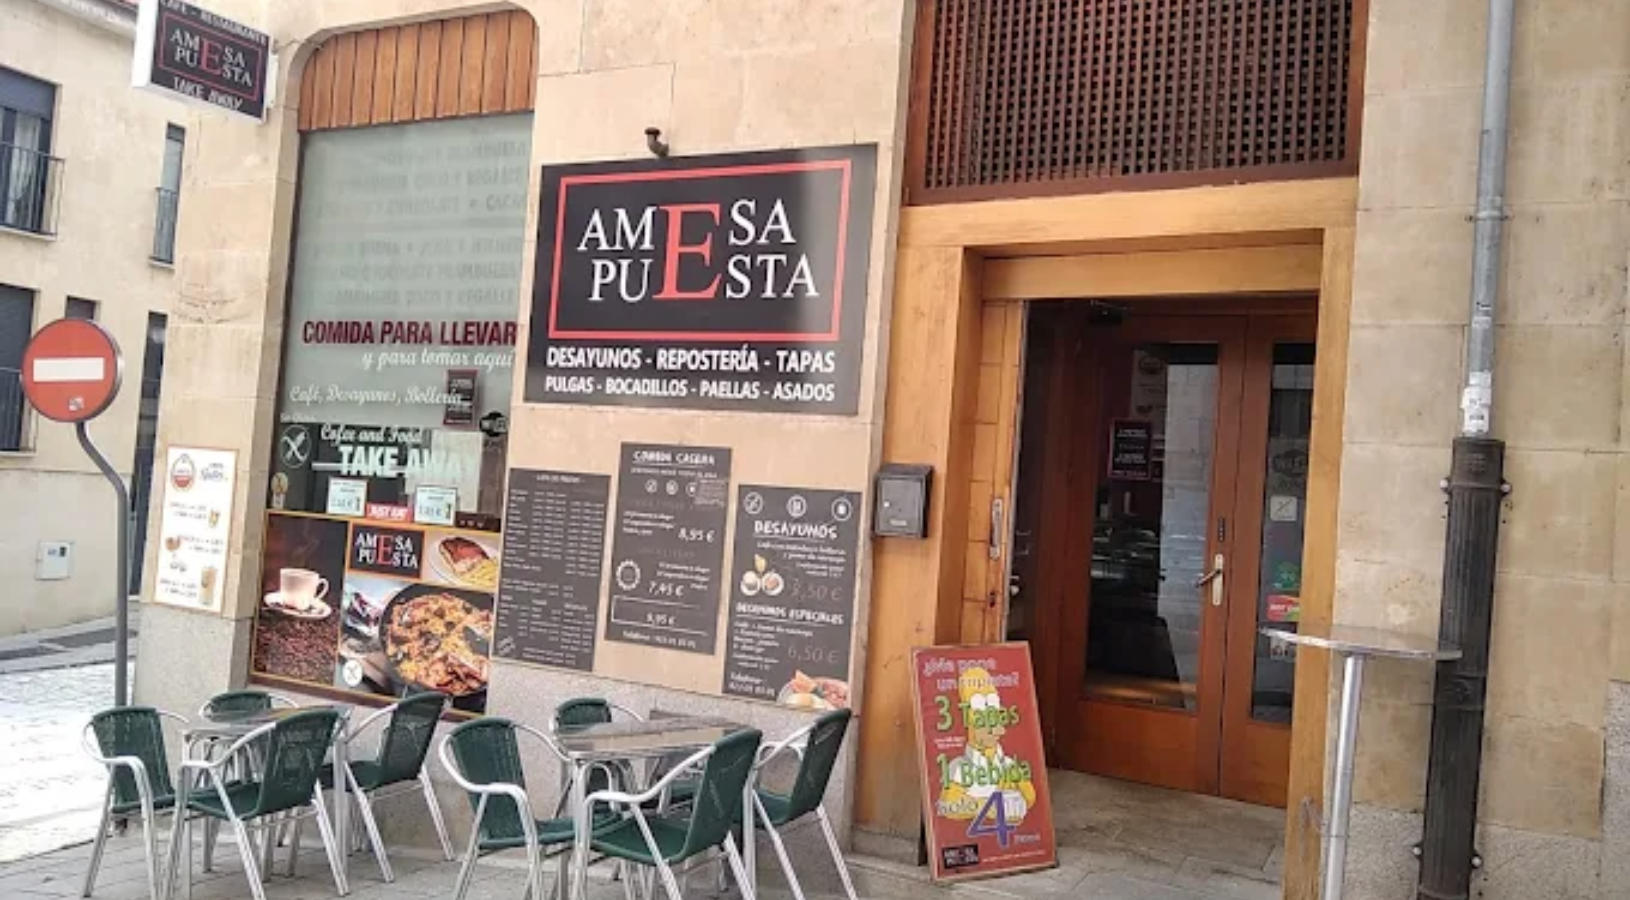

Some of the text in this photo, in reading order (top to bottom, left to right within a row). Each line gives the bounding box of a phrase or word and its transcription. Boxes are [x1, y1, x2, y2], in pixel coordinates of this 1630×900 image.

[173, 76, 205, 98] TAKE
[303, 321, 517, 347] COMIDA PARA LLEVAR
[361, 351, 374, 370] y
[377, 350, 418, 371] para
[420, 348, 470, 366] tomar
[546, 344, 835, 374] DESAYUNOS REPOSTERÍA TAPAS
[545, 376, 835, 401] PULGAS BOCADILLOS PAELLAS ASADOS
[339, 445, 399, 478] TAKE
[754, 520, 838, 541] DESAYUNOS
[934, 695, 1020, 735] 3 Tapas
[937, 752, 1031, 790] 1 Bebida
[966, 790, 1018, 848] 4
